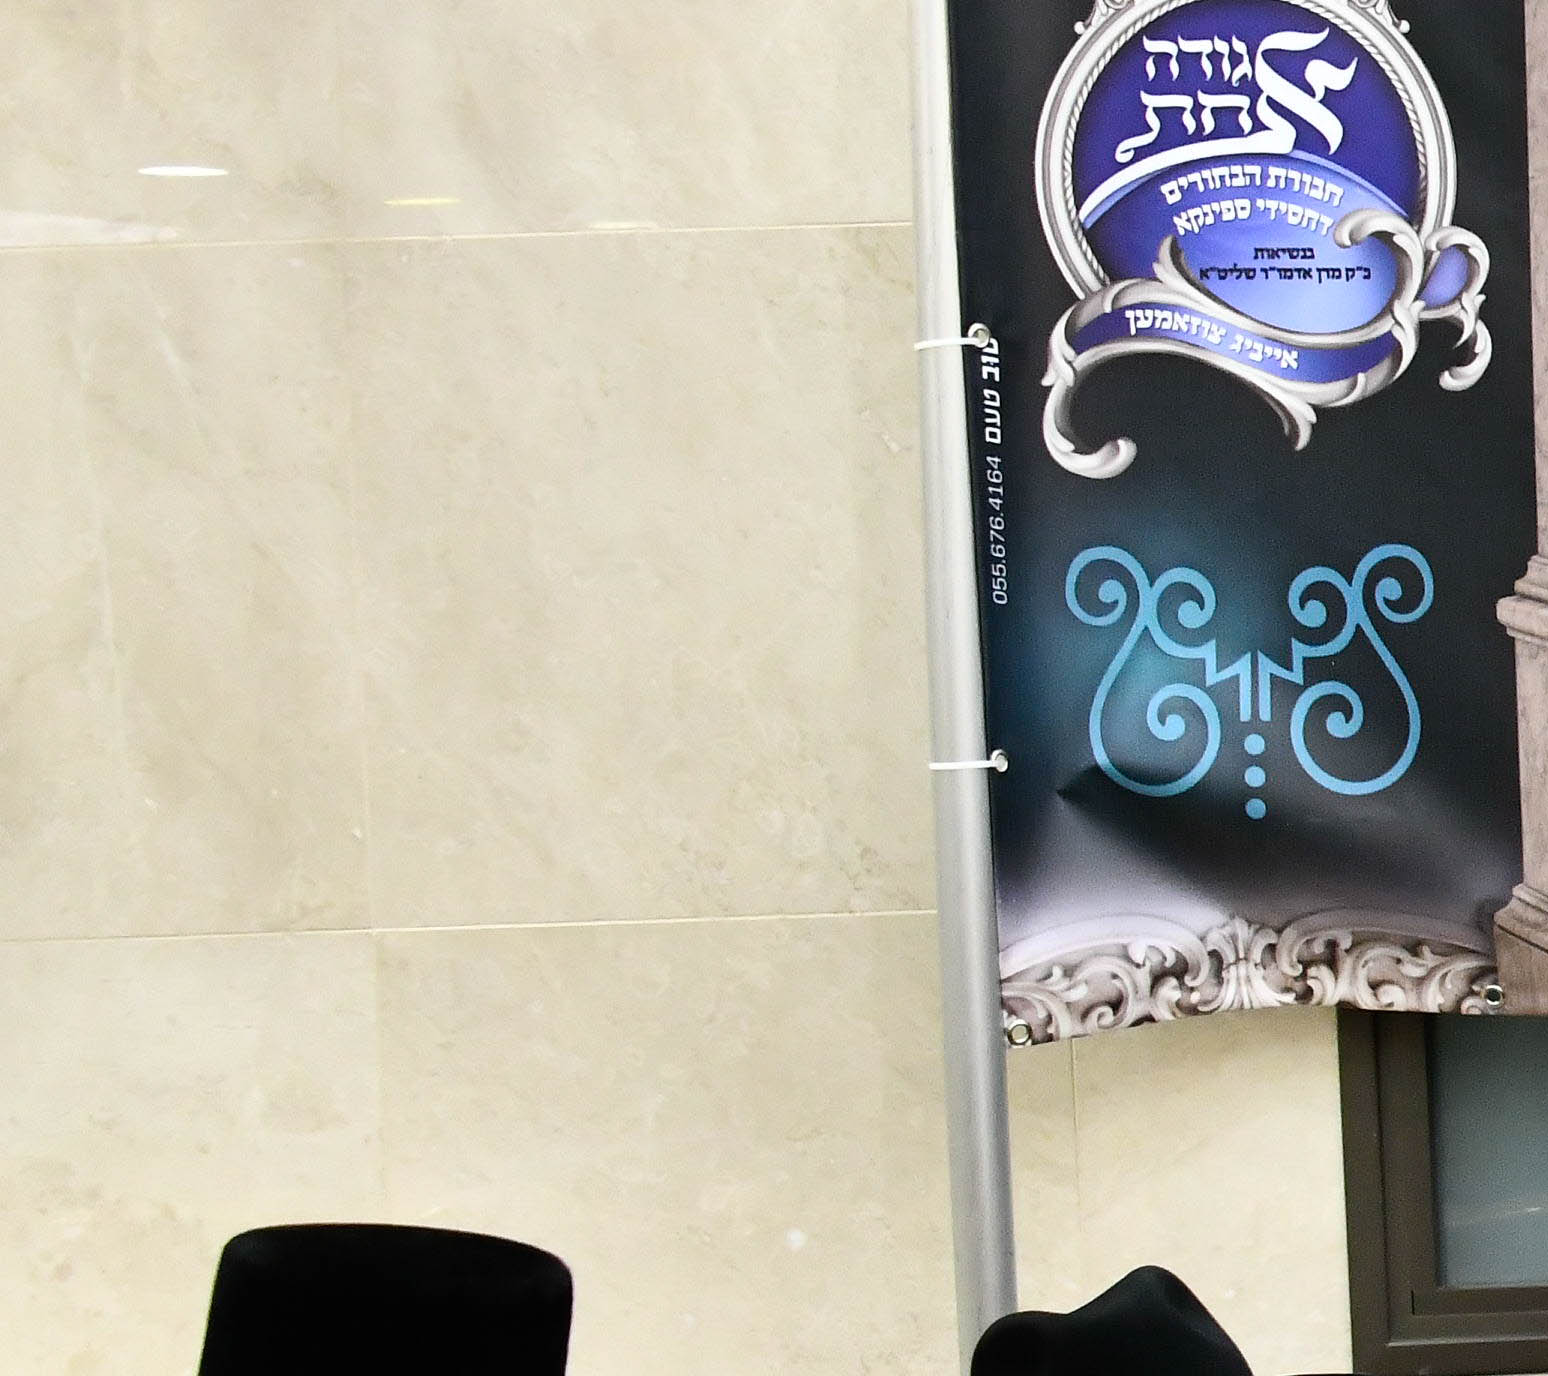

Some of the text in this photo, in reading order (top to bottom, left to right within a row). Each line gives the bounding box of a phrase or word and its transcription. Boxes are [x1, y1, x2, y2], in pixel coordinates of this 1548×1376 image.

[1160, 165, 1344, 206] חבורת הבחורים
[1172, 198, 1334, 236] דחסידי ספינקא
[982, 389, 1003, 445] טעם
[987, 455, 1008, 606] 055.676.4164
